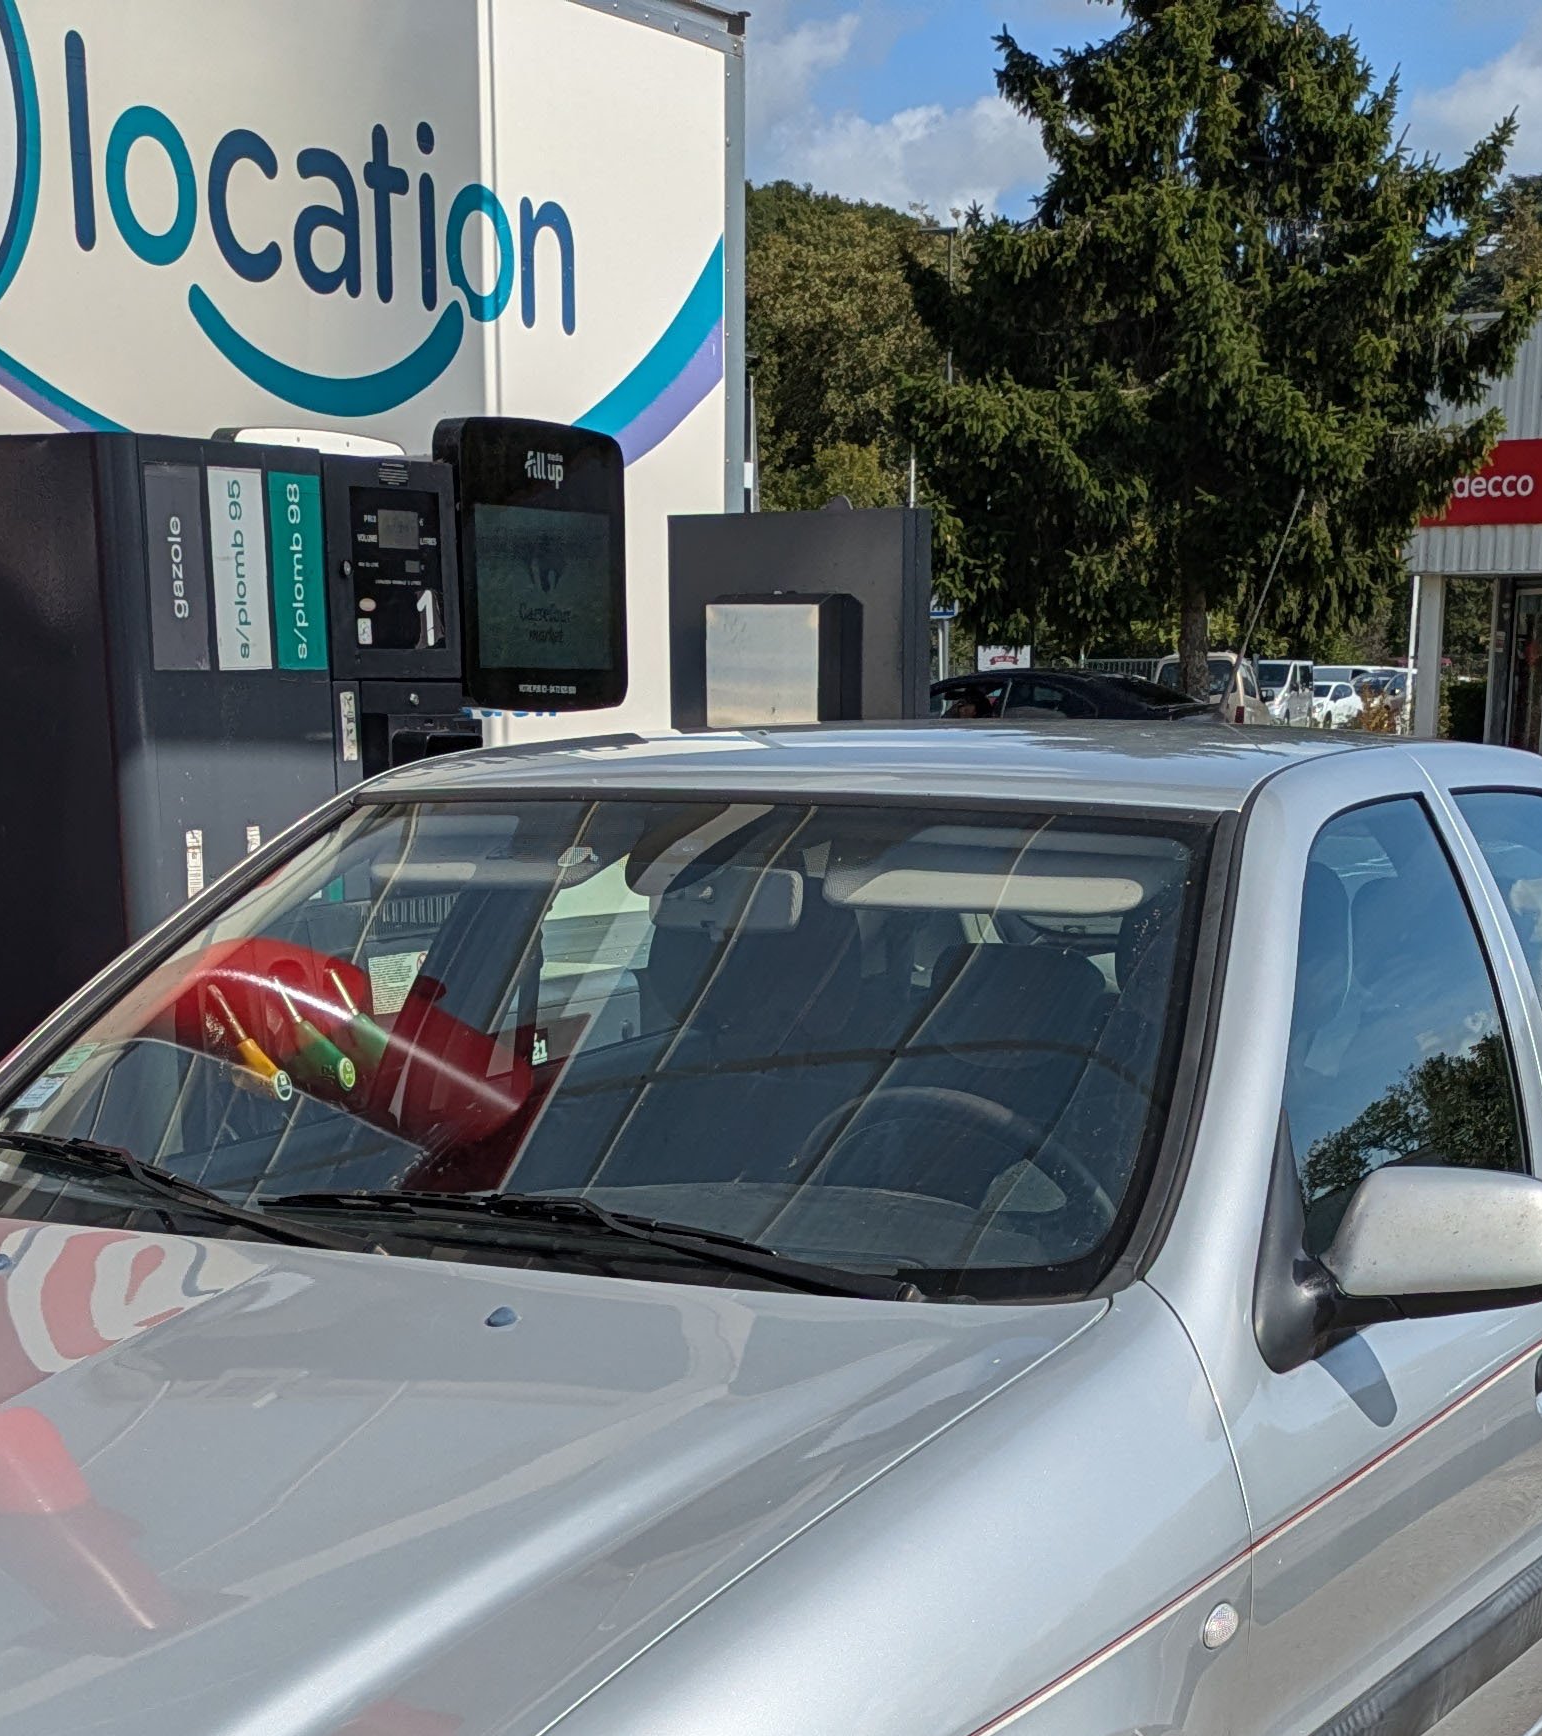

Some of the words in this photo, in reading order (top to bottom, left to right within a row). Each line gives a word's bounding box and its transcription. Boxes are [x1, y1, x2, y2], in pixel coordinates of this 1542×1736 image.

[64, 29, 576, 336] location
[227, 479, 243, 521] 95
[286, 483, 301, 524] 98
[547, 463, 564, 490] up
[1452, 474, 1535, 498] decco
[167, 516, 189, 619] gazole
[231, 530, 252, 659] s/plomb
[290, 533, 309, 659] s/plomb
[416, 589, 435, 647] 1
